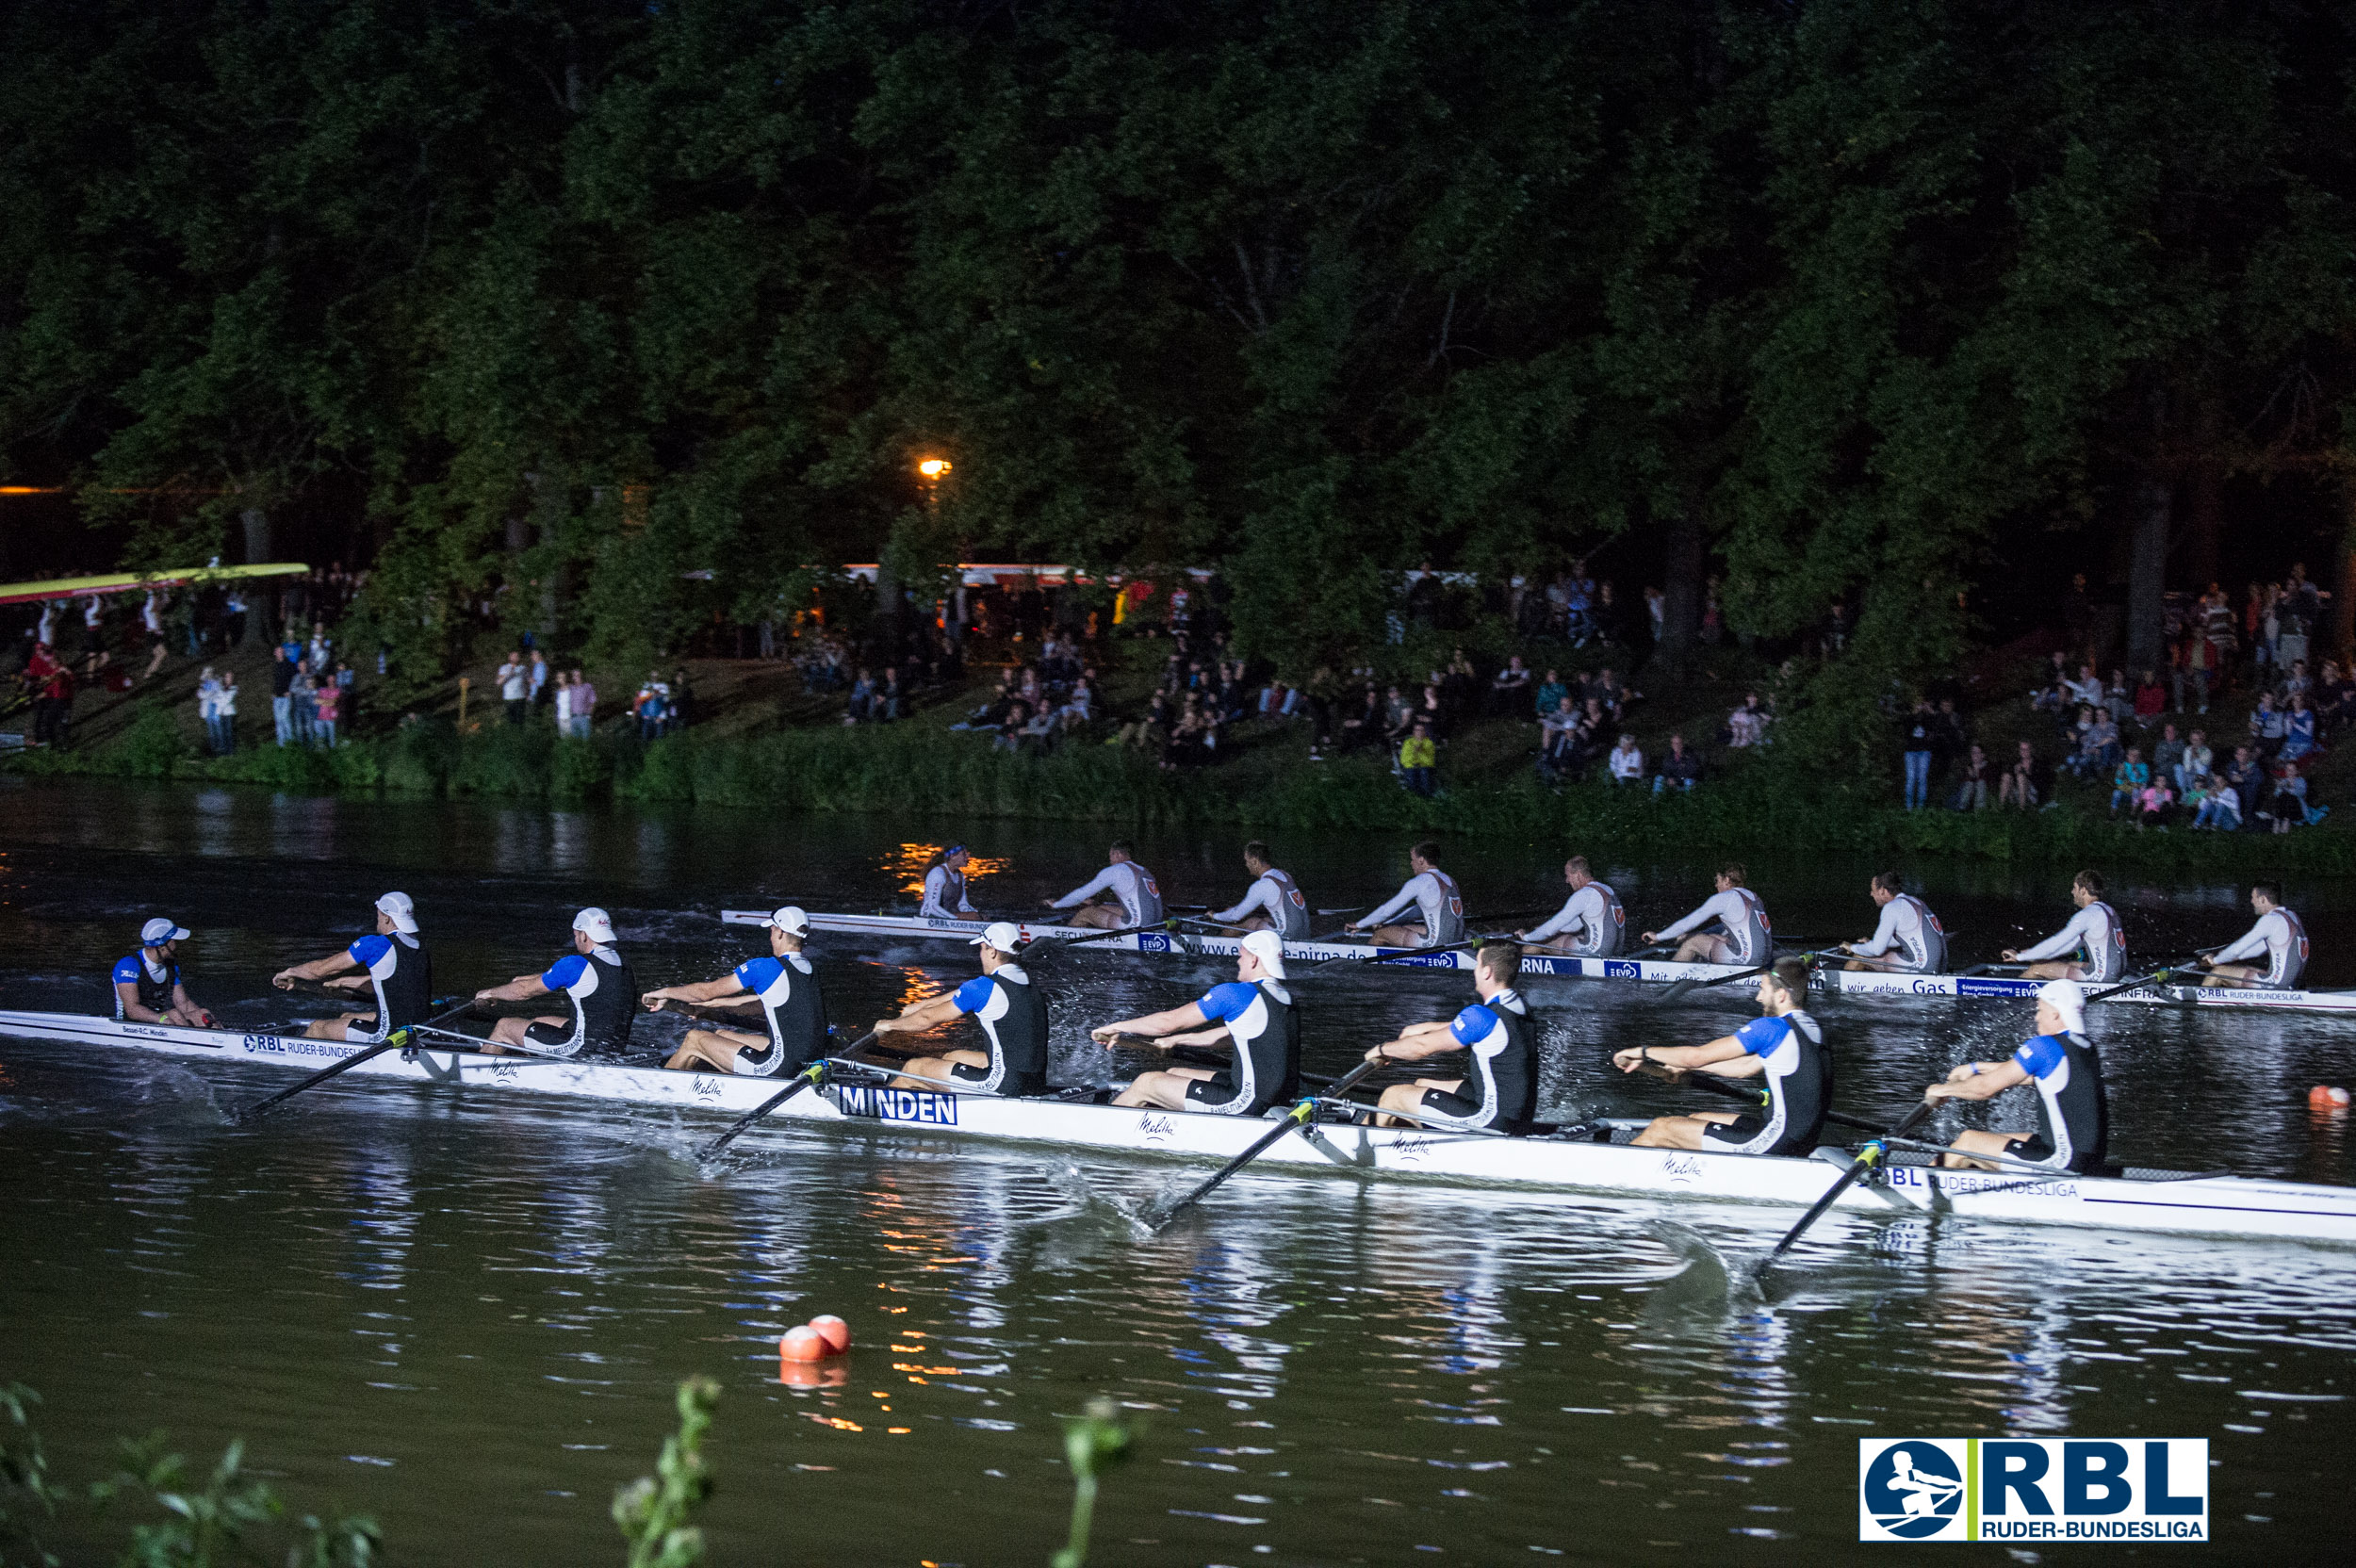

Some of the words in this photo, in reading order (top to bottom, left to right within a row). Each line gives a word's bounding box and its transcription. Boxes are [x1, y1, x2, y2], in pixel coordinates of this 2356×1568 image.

[1147, 940, 1161, 950] EVP
[1432, 958, 1448, 967] EVP
[1518, 957, 1555, 975] RNA
[1615, 968, 1631, 977] EVP
[1651, 972, 1668, 982] Mit
[1847, 982, 1867, 993] wir
[1912, 979, 1946, 995] Gas
[1962, 984, 2013, 995] Energieversorgung
[2208, 989, 2227, 998] RBL
[2230, 991, 2303, 1002] RUDER-BUNDESLIGA
[257, 1036, 286, 1052] RBL
[488, 1056, 519, 1079] Melitta
[688, 1073, 722, 1097] Melitta
[842, 1086, 956, 1124] MINDEN
[1134, 1111, 1174, 1135] Melitta
[1388, 1130, 1431, 1155] Melitta
[1657, 1151, 1702, 1177] Melitta
[1929, 1176, 2079, 1197] RUDER-BUNDESLIGA
